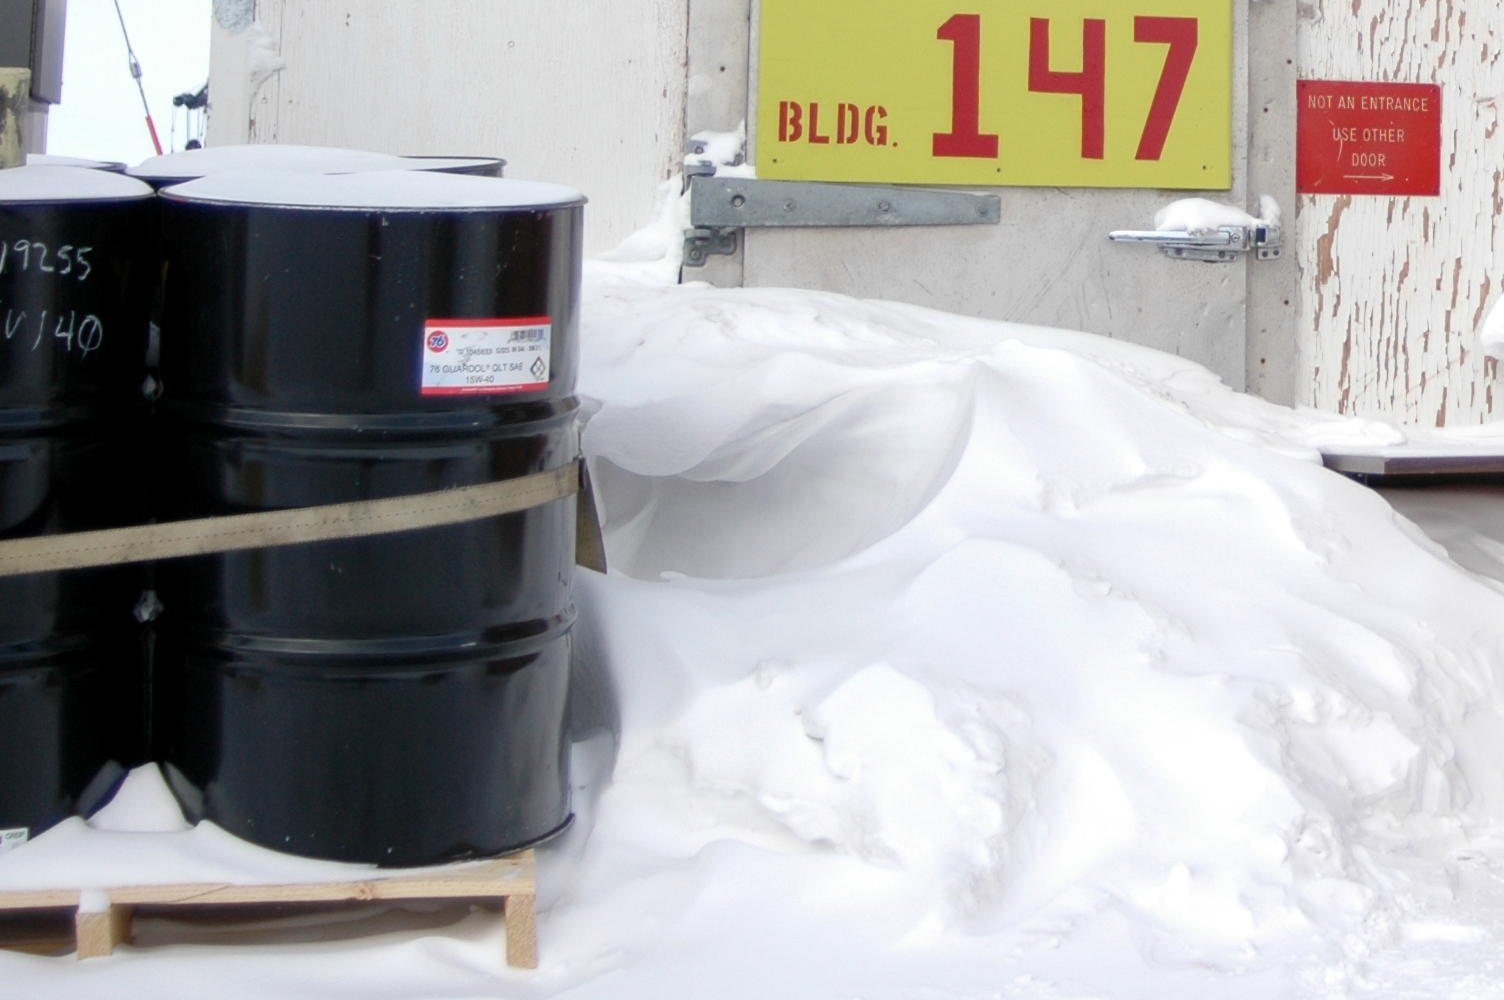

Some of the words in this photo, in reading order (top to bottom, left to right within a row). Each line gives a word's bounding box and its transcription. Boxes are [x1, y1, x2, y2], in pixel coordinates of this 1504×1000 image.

[777, 100, 898, 147] BLDG.
[931, 12, 1199, 161] 147
[1308, 95, 1333, 109] NOT
[1338, 96, 1355, 110] AN
[1361, 96, 1429, 111] ENTRANCE
[1333, 127, 1357, 142] USE
[1362, 128, 1405, 142] OTHER
[1352, 153, 1386, 167] DOOR
[431, 336, 446, 347] 76
[430, 364, 440, 374] 76
[509, 362, 524, 371] SAE
